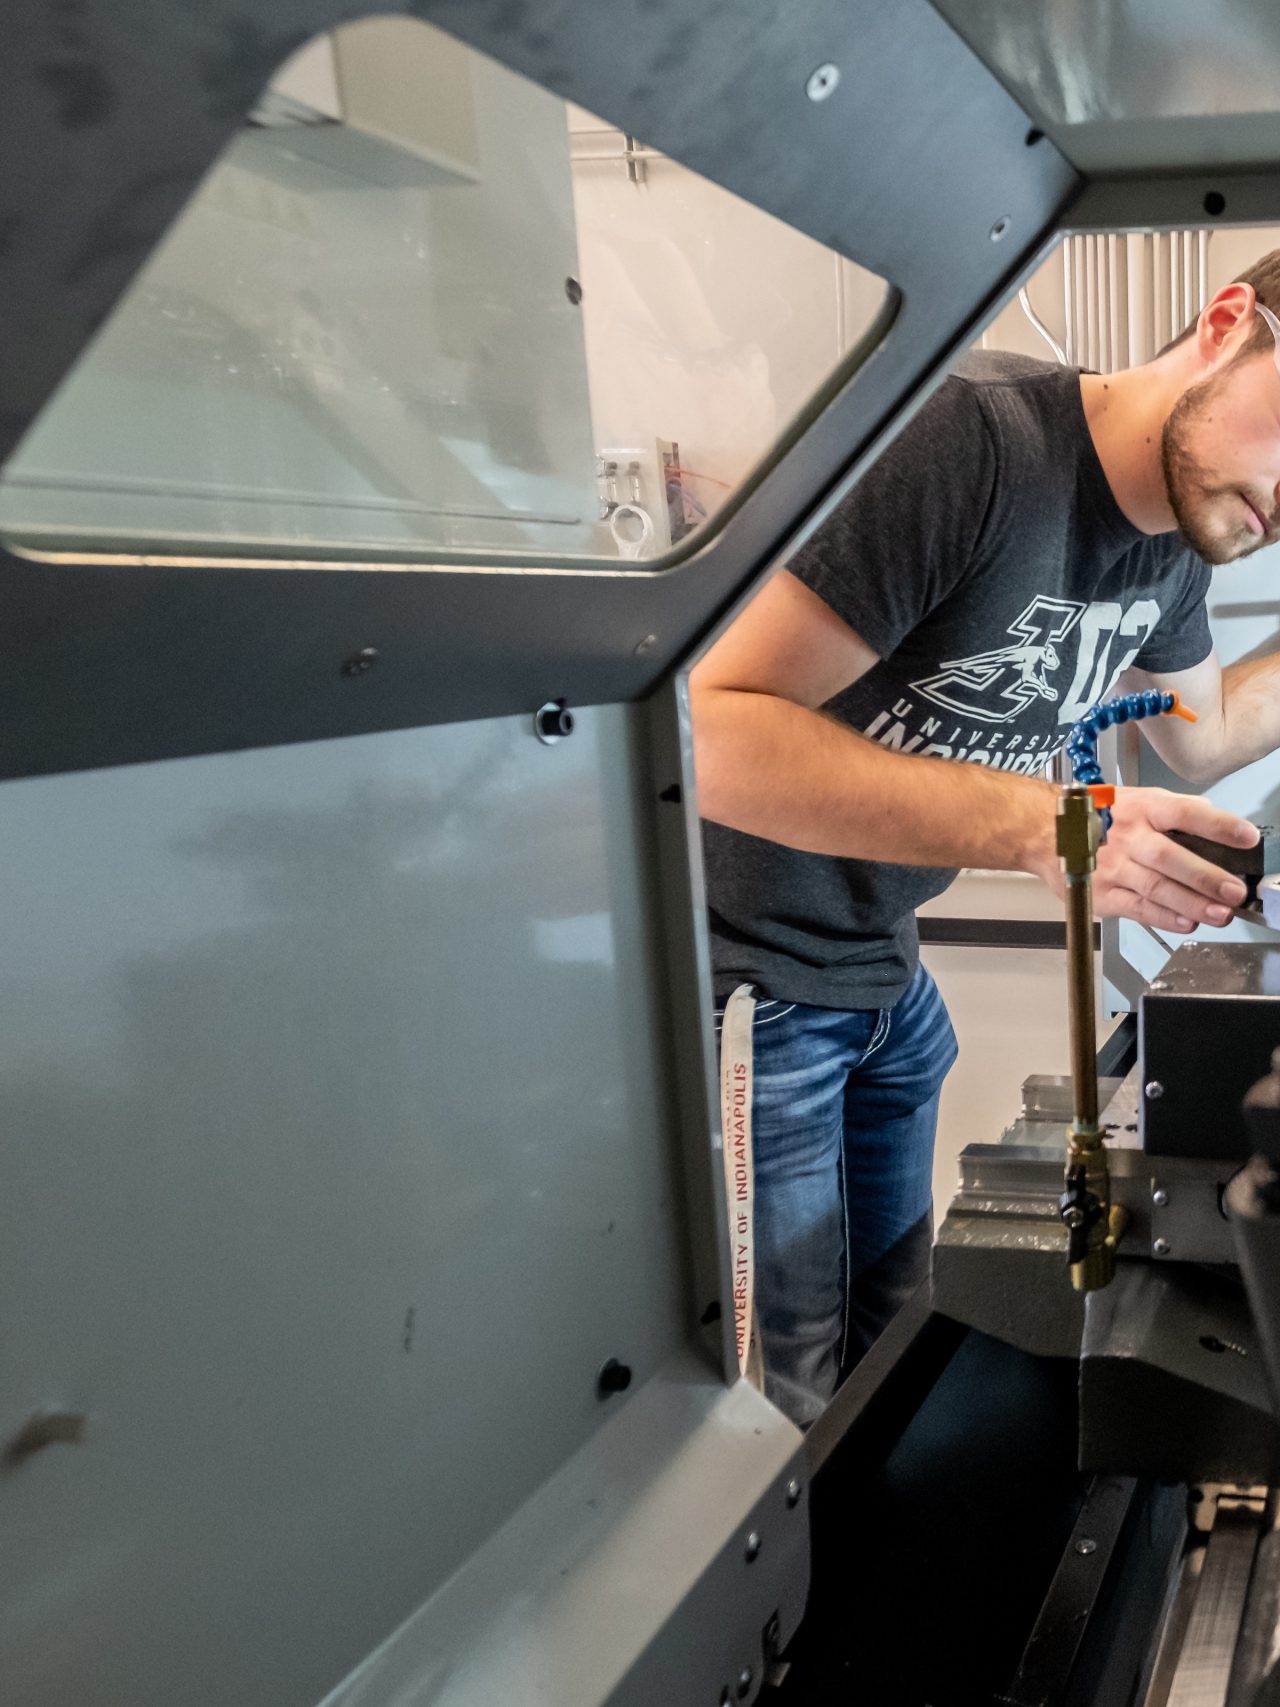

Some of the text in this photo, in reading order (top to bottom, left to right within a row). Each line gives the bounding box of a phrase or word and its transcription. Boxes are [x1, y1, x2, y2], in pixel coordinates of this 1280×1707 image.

[734, 1063, 748, 1358] UNIVERSITY OF INDIANAPOLIS
